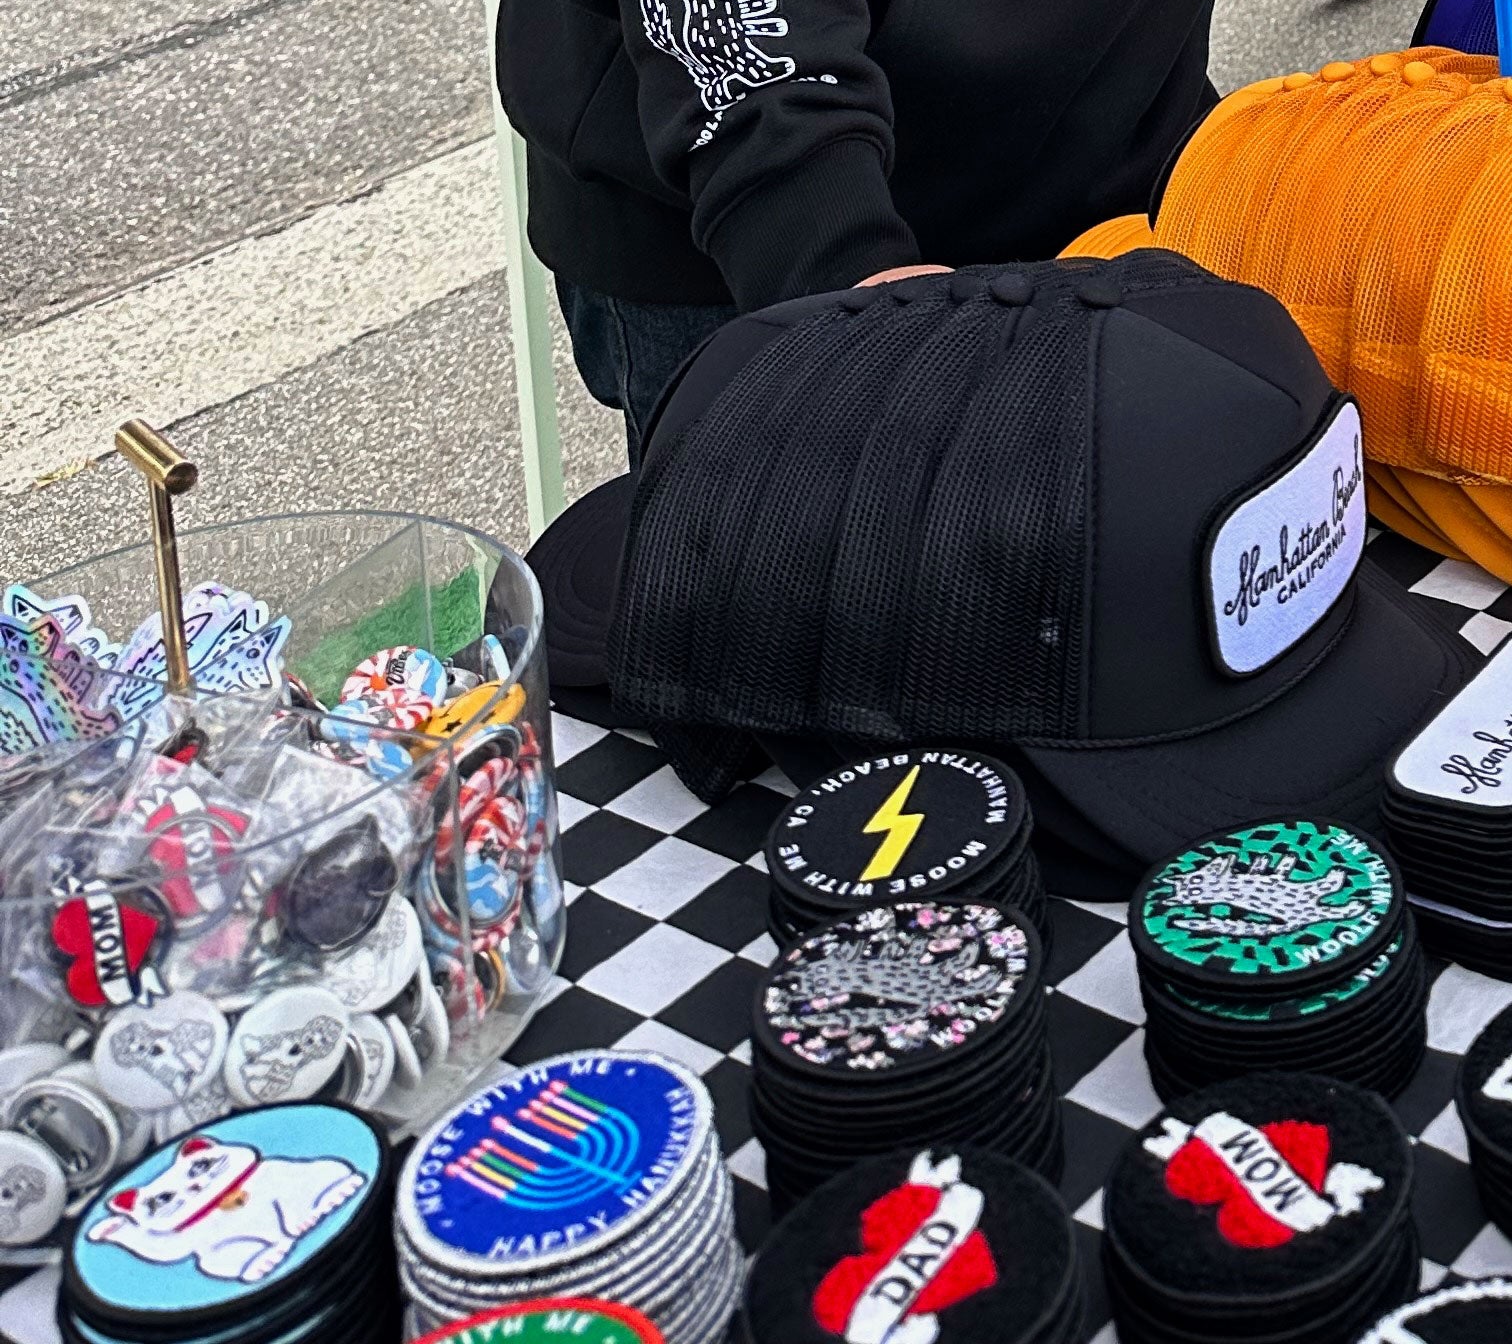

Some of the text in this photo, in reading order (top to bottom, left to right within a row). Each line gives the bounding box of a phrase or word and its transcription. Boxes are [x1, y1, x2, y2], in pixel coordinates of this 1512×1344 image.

[1223, 433, 1362, 626] Manhattan Beach
[1277, 523, 1347, 604] CALIFORNIA
[787, 804, 815, 828] CA
[921, 751, 1009, 824] MANHATTAN
[778, 839, 988, 897] MOOSE WITH ME
[1330, 833, 1369, 856] ME
[1365, 858, 1393, 907] WITH
[1295, 912, 1381, 965] WOOLF
[416, 1058, 613, 1215] MOOSE WITH ME
[1221, 1129, 1304, 1213] MOM
[487, 1210, 610, 1260] HAPPY
[873, 1218, 957, 1310] DAD
[542, 1312, 595, 1335] ME
